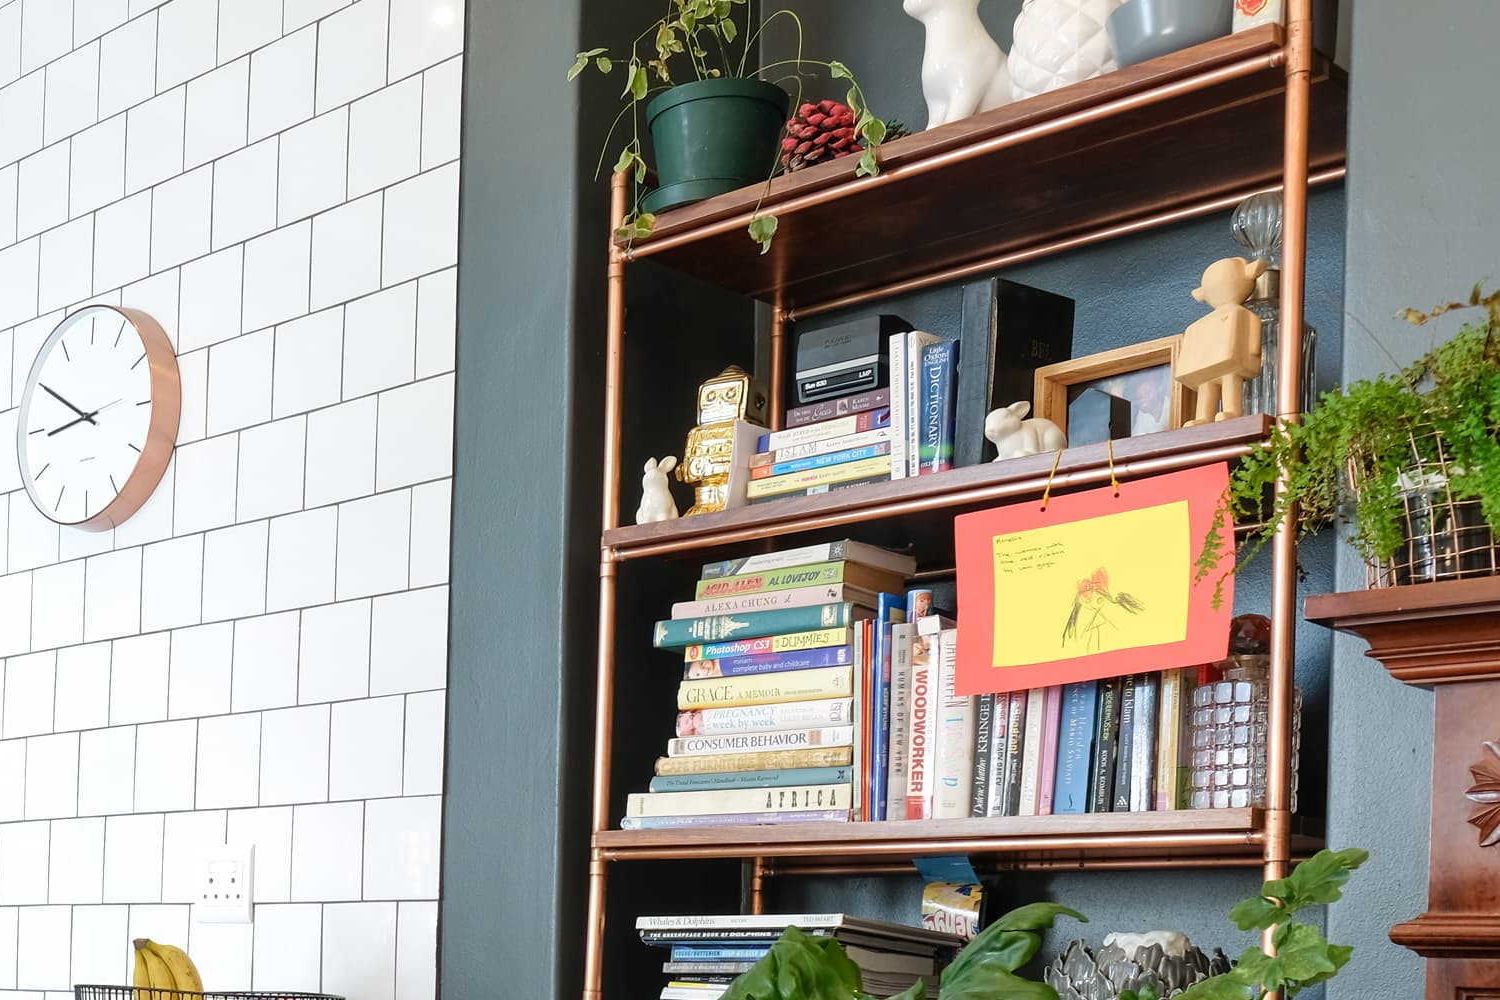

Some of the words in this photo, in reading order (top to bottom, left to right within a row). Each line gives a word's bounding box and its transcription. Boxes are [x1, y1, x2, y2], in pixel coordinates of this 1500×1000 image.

[928, 365, 942, 448] DICTIONARY
[816, 456, 832, 465] NEW
[833, 452, 851, 462] YORK
[852, 449, 868, 459] CITY
[768, 577, 779, 586] AL
[782, 571, 821, 585] LOVEJOY
[704, 601, 738, 613] ALEXA
[741, 597, 778, 609] CHUNG
[705, 643, 751, 656] Photoshop
[753, 640, 770, 650] CS3
[781, 633, 830, 648] DUMMIES
[732, 664, 758, 673] complete
[759, 663, 772, 672] baby
[784, 659, 810, 669] childcare
[686, 685, 734, 704] GRACE
[745, 688, 781, 699] MEMOIR
[897, 671, 905, 707] HUMANS
[713, 707, 776, 720] PREGNANCY
[1123, 698, 1134, 724] Islam
[712, 720, 736, 730] week
[738, 718, 748, 730] by
[751, 717, 776, 728] week
[911, 669, 928, 793] WOODWORKER
[977, 703, 990, 753] KRINGE
[1067, 718, 1077, 747] MARIO
[687, 735, 748, 751] CONSUMER
[751, 732, 806, 748] BEHAVIOR
[766, 789, 836, 809] AFRICA
[649, 917, 675, 927] Whales
[682, 917, 715, 928] Dolphins
